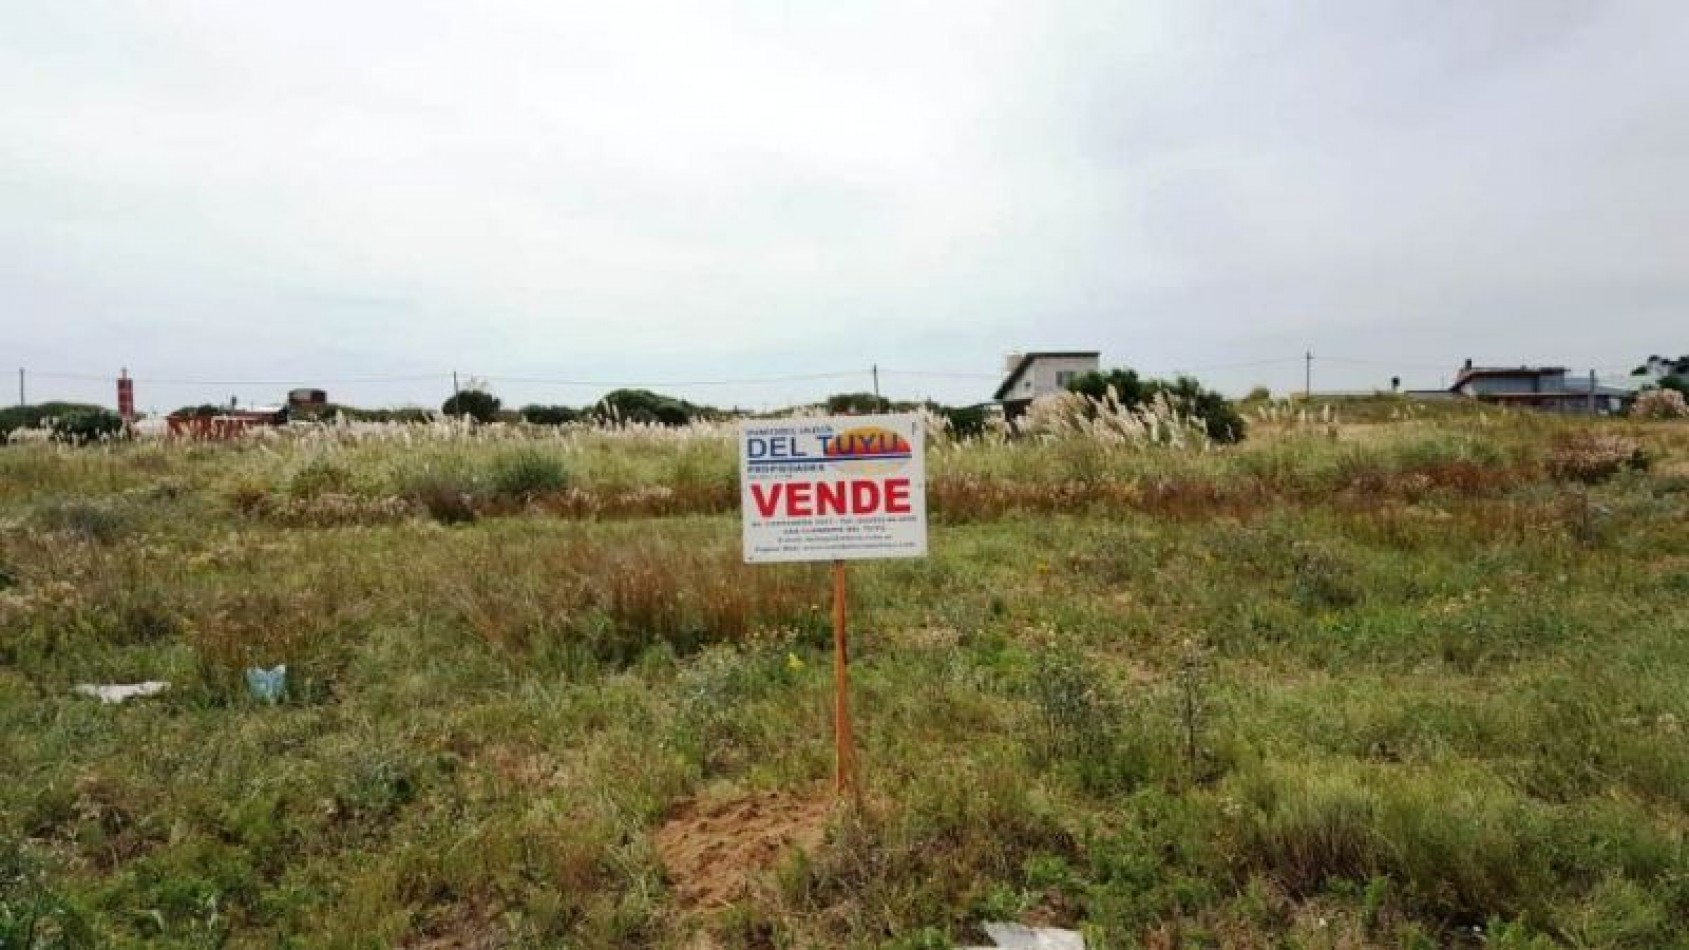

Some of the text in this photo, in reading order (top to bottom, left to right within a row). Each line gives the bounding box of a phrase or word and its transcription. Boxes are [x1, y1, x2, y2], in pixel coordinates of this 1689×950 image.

[748, 434, 898, 457] DEL TUYU
[751, 478, 910, 518] VENDE
